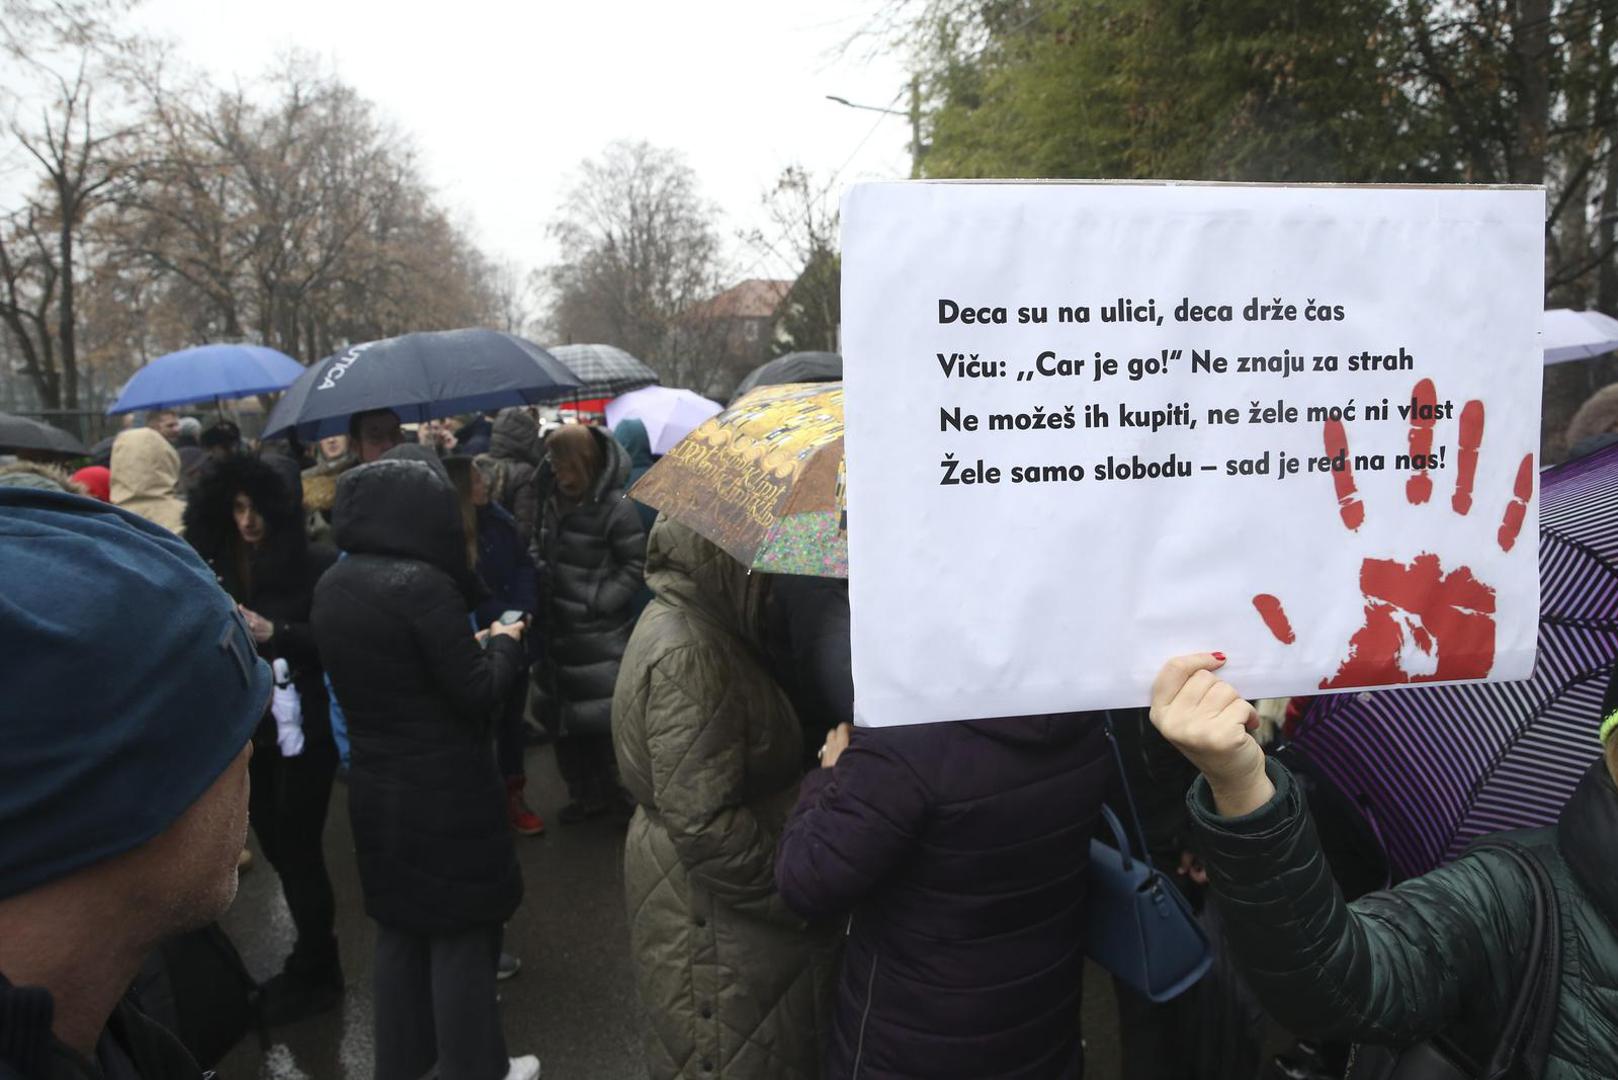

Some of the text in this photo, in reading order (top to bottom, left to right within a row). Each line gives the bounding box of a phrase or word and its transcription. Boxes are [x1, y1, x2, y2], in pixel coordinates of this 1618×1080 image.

[938, 297, 1345, 327] Deca su na ulici, deca drže čas
[317, 343, 371, 390] UTICA
[936, 353, 1007, 379] Viču:
[1093, 351, 1118, 382] je
[1191, 349, 1228, 374] Ne
[1236, 348, 1305, 378] znaju
[1312, 355, 1338, 372] za
[1348, 347, 1414, 372] strah
[940, 396, 1454, 433] Ne možeš ih kupiti, ne žele moć ni vlast
[939, 452, 1001, 486] Žele
[1010, 464, 1085, 484] samo
[1094, 453, 1192, 481] slobodu
[1226, 450, 1270, 476] sad
[1277, 451, 1300, 481] je
[1307, 447, 1346, 473] red
[1354, 454, 1385, 471] na
[1395, 445, 1446, 471] nas!
